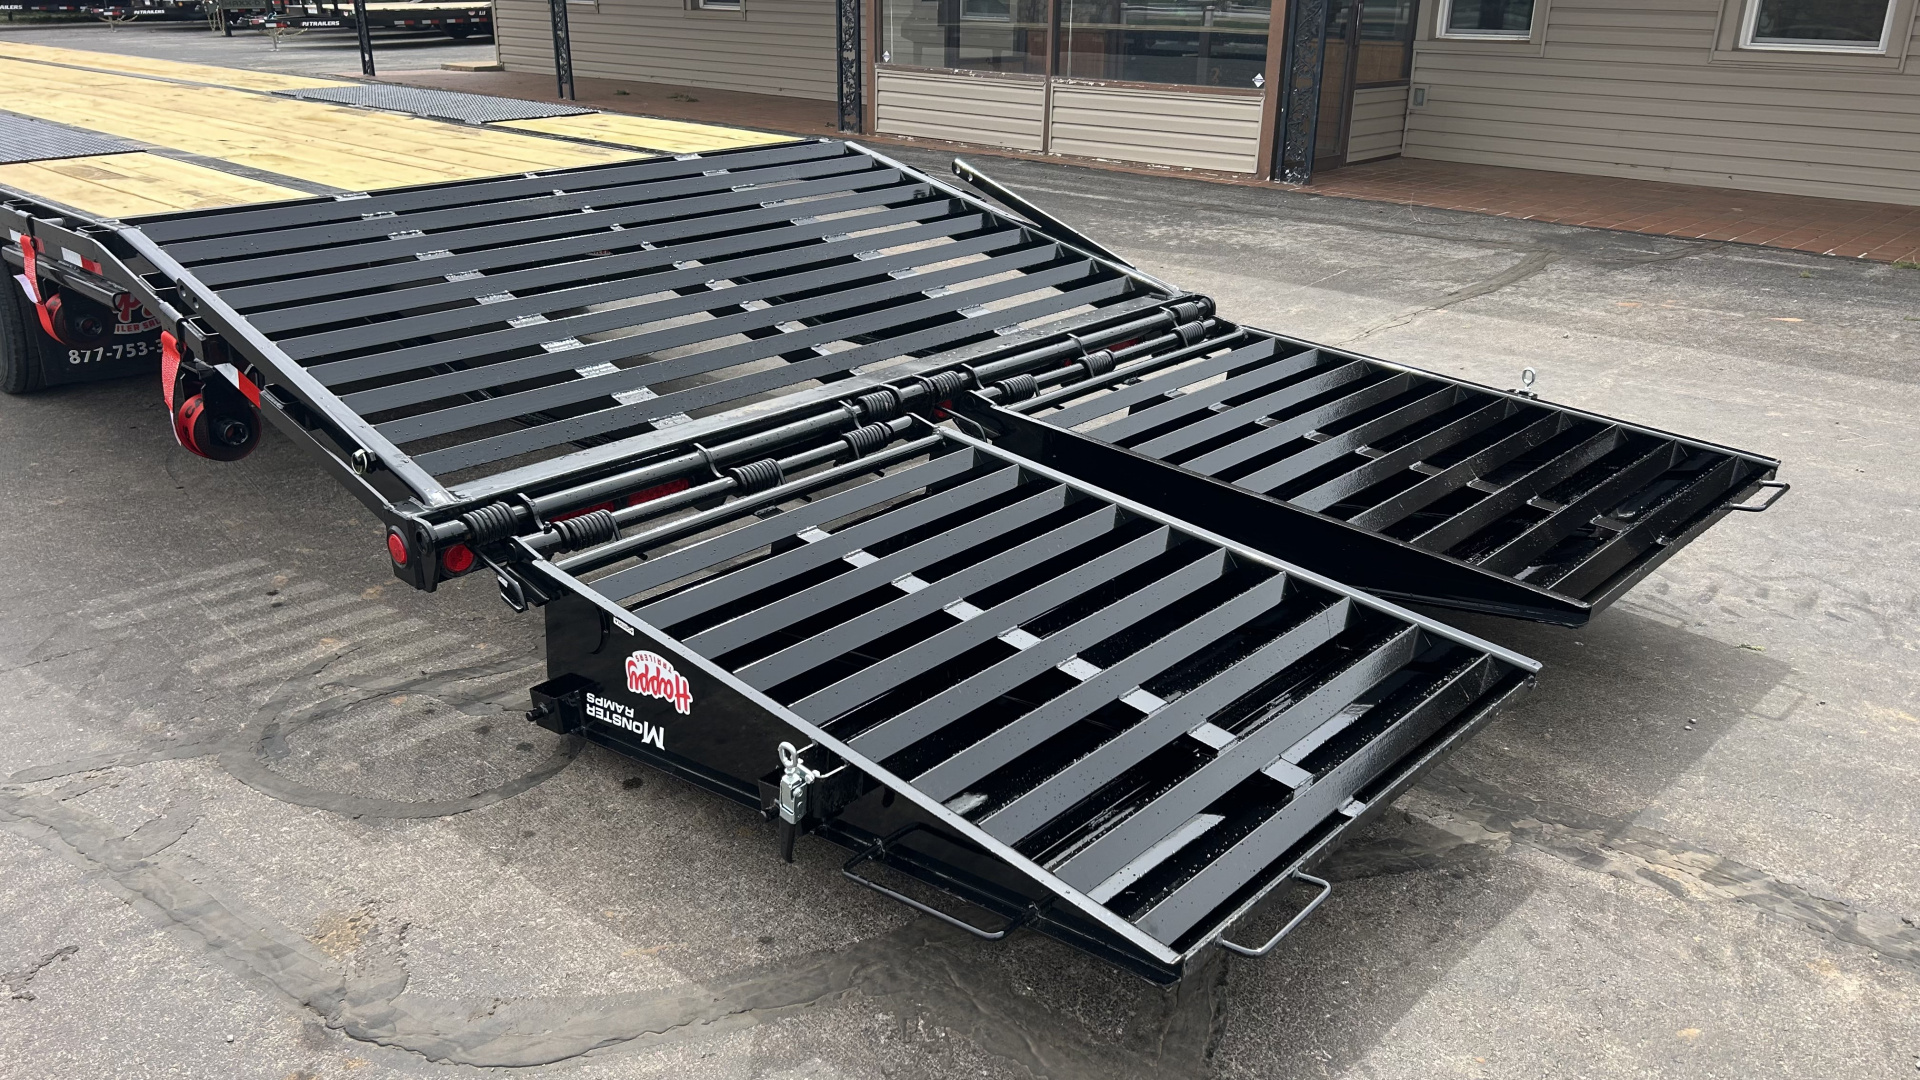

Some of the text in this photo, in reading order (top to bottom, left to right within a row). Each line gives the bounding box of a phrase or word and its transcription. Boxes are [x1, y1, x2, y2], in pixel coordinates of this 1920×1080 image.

[635, 653, 673, 674] TRAILERS
[626, 658, 692, 714] Happy
[586, 692, 635, 719] RAMPS
